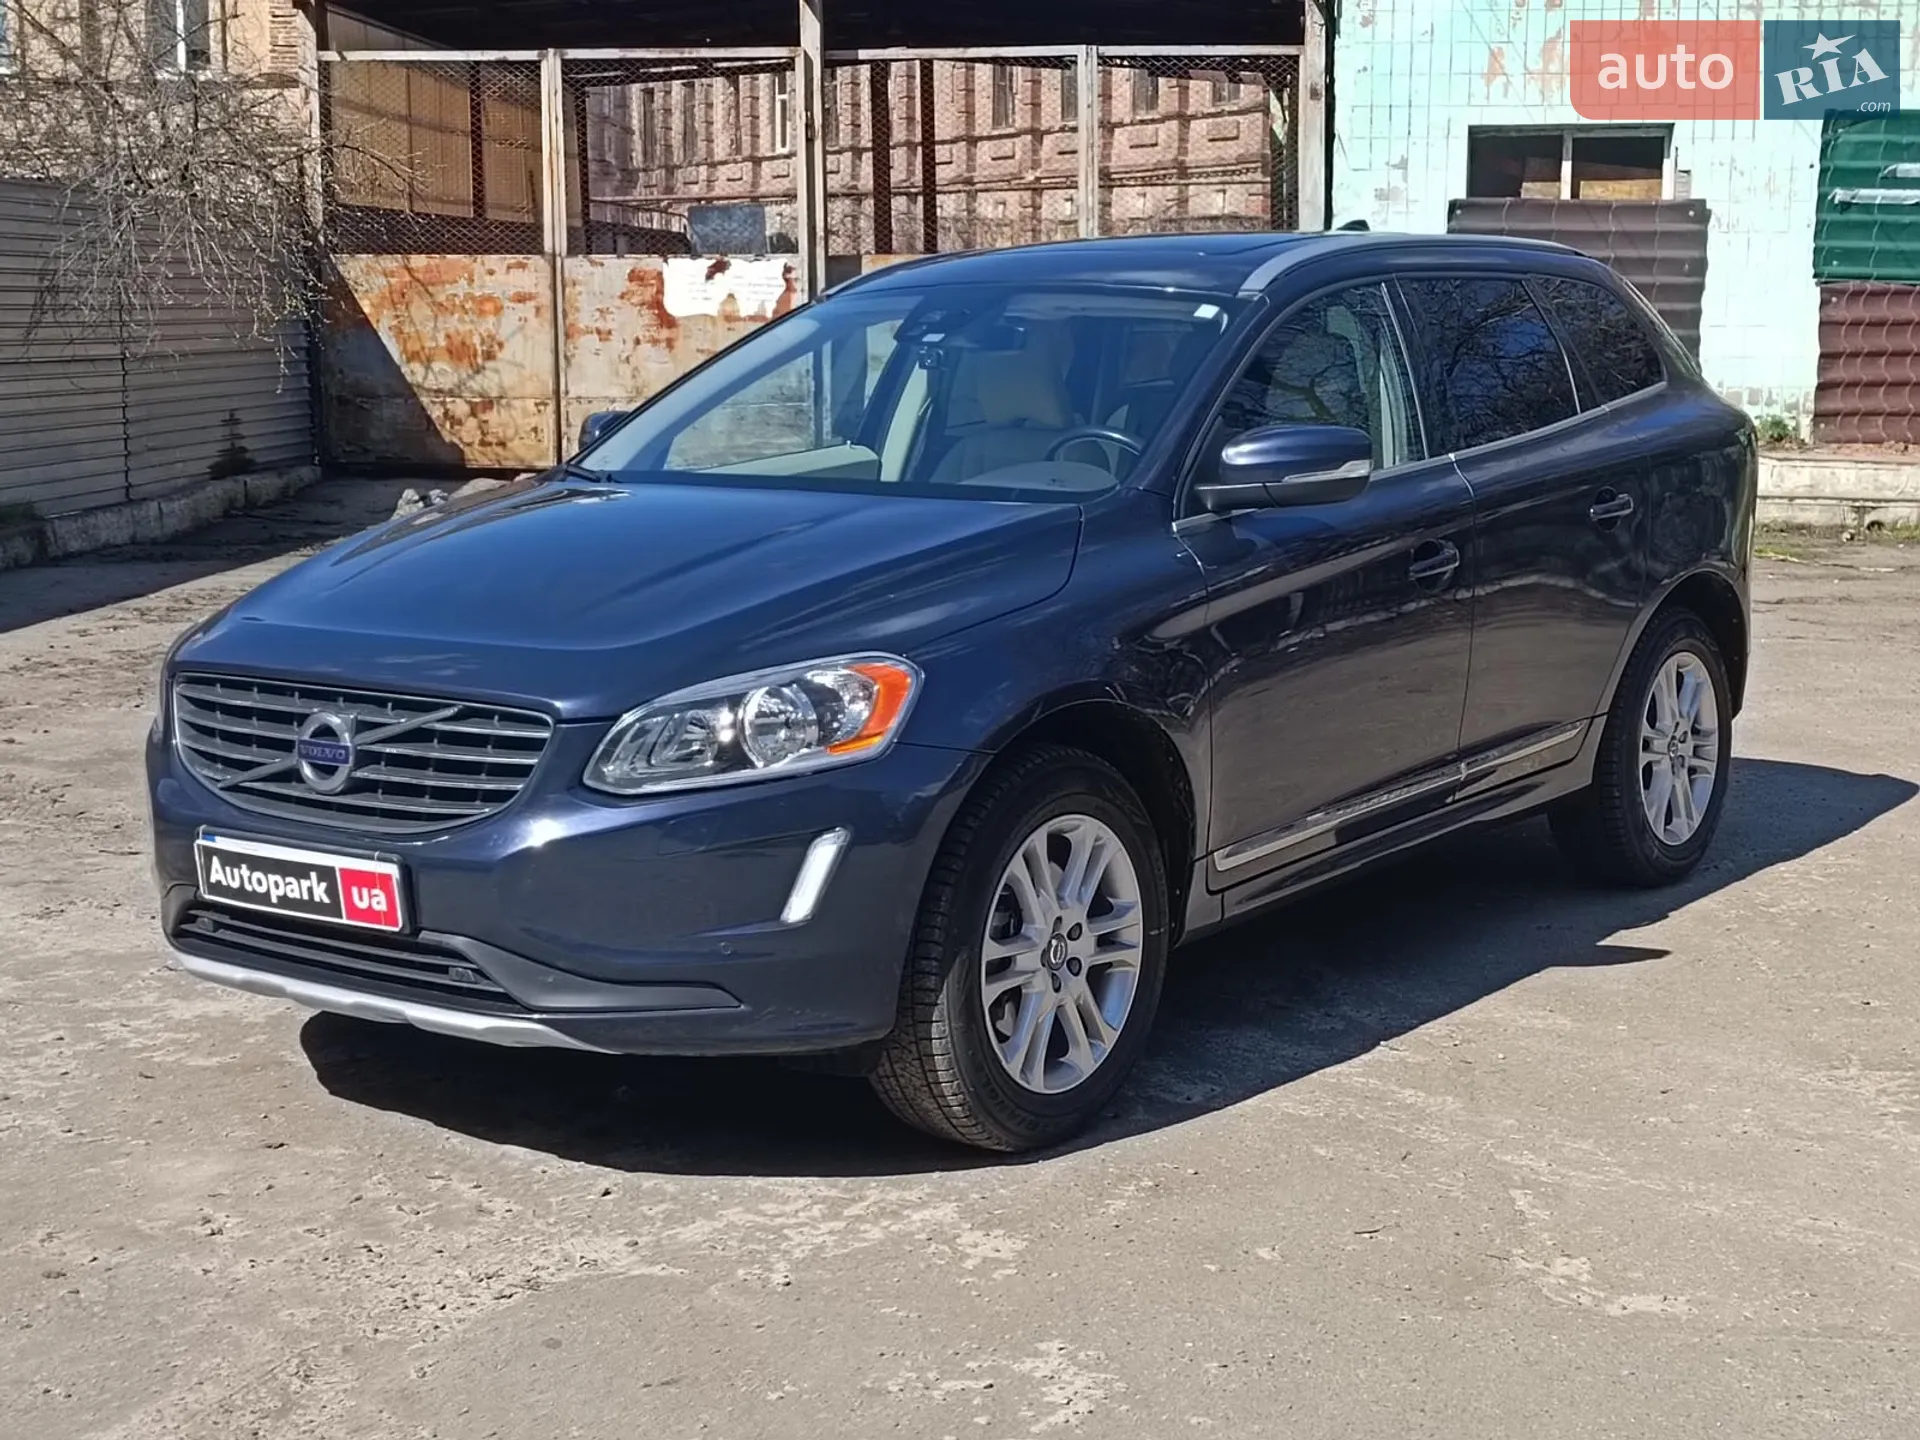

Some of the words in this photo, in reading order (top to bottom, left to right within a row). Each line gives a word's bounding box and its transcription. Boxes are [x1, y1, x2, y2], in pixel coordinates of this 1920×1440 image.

[300, 744, 346, 760] VOLVO
[210, 855, 330, 903] Autopark
[352, 885, 388, 912] ua
